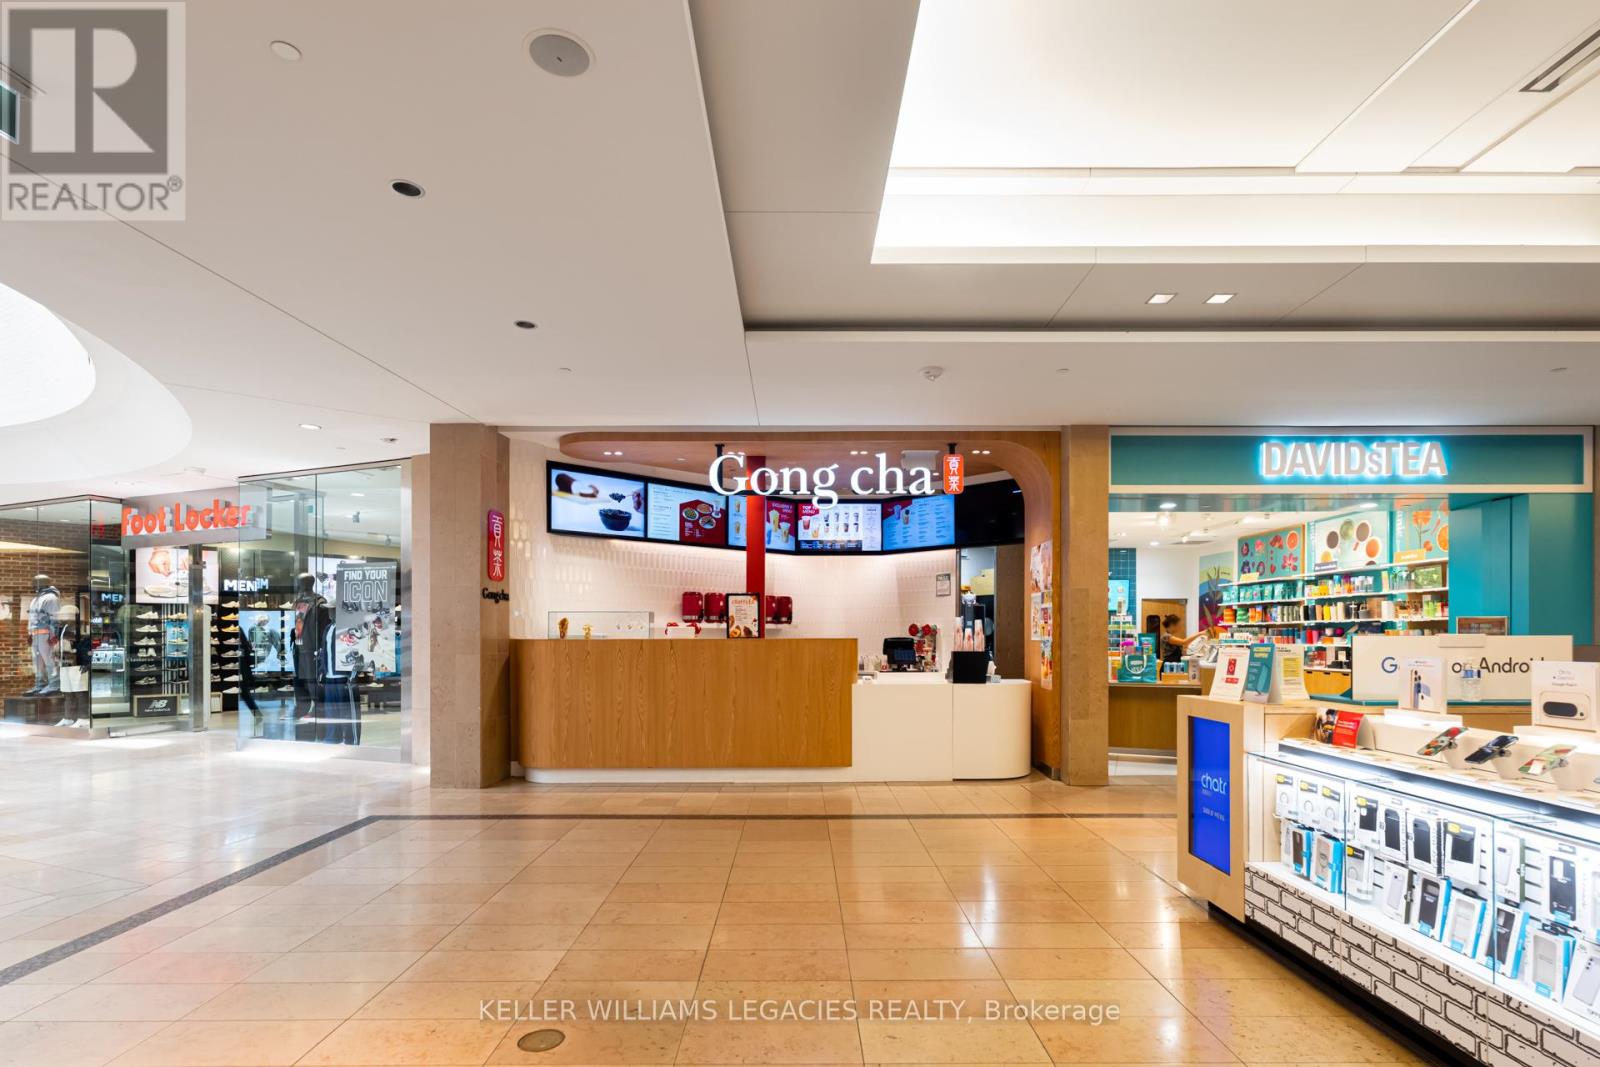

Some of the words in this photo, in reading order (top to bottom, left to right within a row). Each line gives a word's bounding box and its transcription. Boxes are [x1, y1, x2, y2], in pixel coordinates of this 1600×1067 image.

[708, 453, 839, 510] Gong
[850, 452, 935, 495] cha
[121, 505, 168, 536] Foot
[174, 499, 252, 532] Locker
[344, 570, 363, 580] FIND
[365, 569, 388, 580] YOUR
[343, 580, 388, 603] ICON
[1479, 657, 1545, 673] Andro
[1200, 772, 1227, 795] chatr
